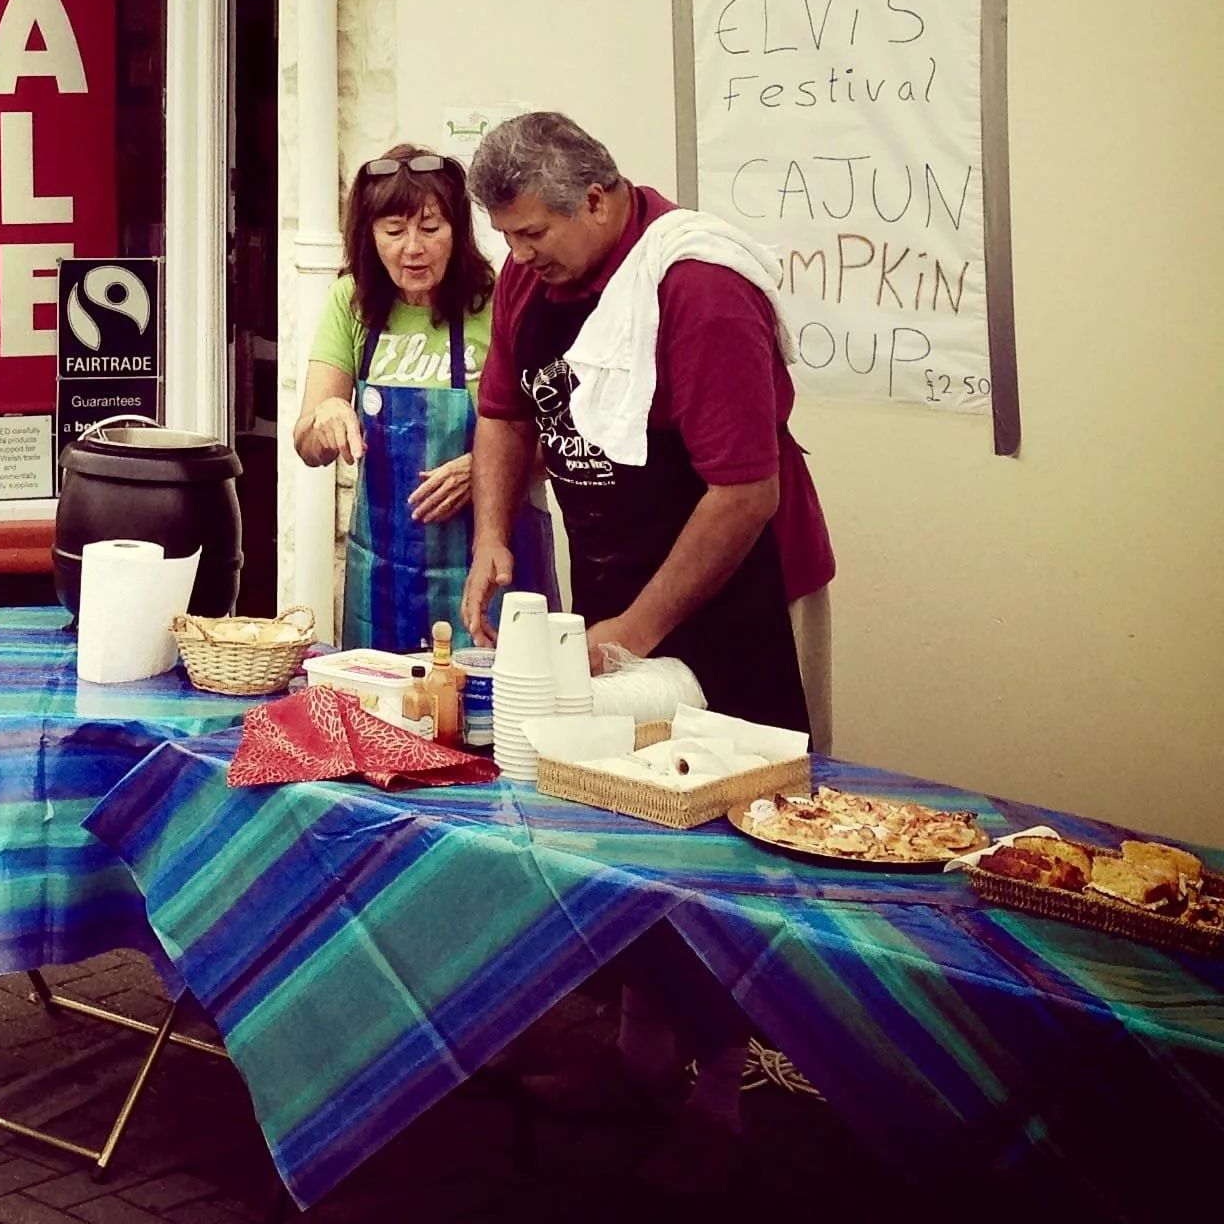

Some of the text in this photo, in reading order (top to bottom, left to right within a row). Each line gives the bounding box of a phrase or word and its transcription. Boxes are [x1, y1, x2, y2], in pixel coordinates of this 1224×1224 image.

[723, 57, 936, 111] Festival
[732, 155, 972, 230] CAJUN
[66, 356, 152, 373] FAIRTRADE
[799, 322, 931, 398] OUP
[71, 395, 142, 408] Guarantees
[63, 422, 71, 433] a
